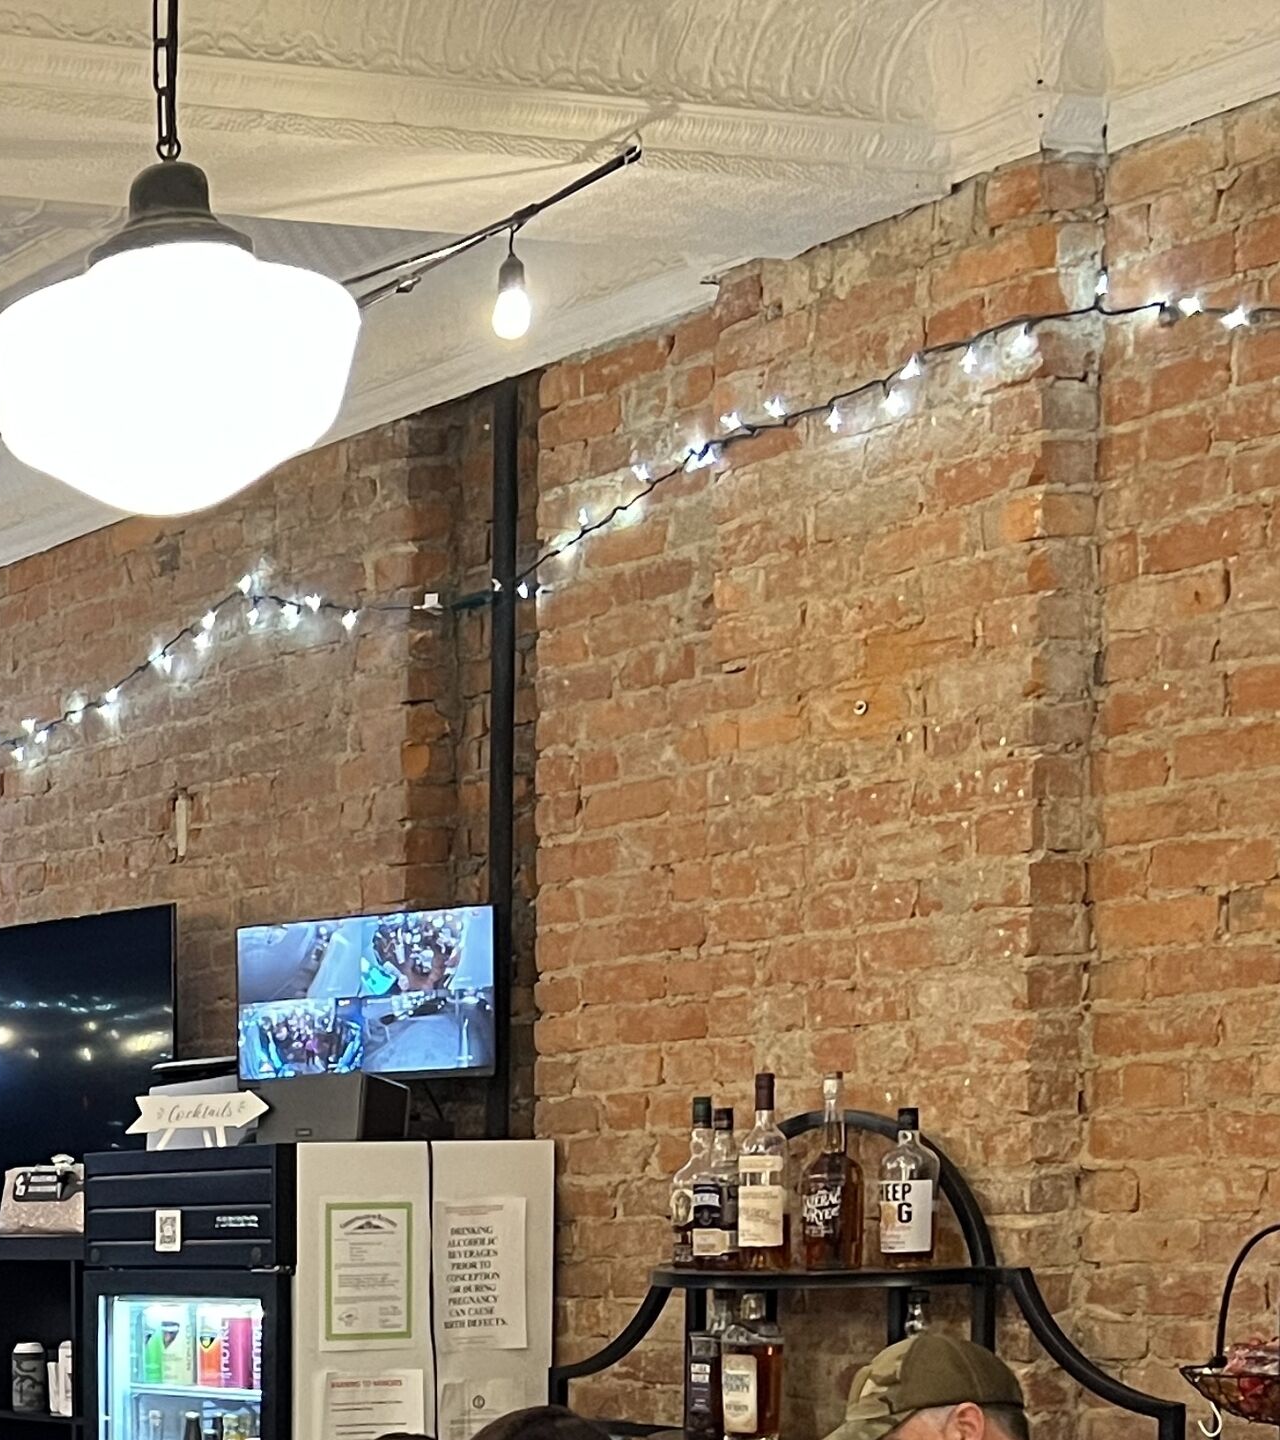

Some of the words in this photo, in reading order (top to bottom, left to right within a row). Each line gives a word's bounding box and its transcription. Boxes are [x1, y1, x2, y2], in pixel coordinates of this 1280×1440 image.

[168, 1102, 232, 1123] Cocktails
[450, 1226, 493, 1235] DRINKING
[447, 1236, 497, 1248] ALCOHOLIC
[448, 1249, 498, 1259] BEVERAGES
[451, 1262, 477, 1271] PRIOR
[480, 1261, 491, 1269] TO
[446, 1271, 500, 1282] CONCEPTION
[449, 1285, 461, 1294] OR
[463, 1283, 496, 1293] DURING
[448, 1295, 498, 1306] PREGNANCY
[449, 1307, 466, 1317] CAN
[468, 1306, 495, 1316] CAUSE
